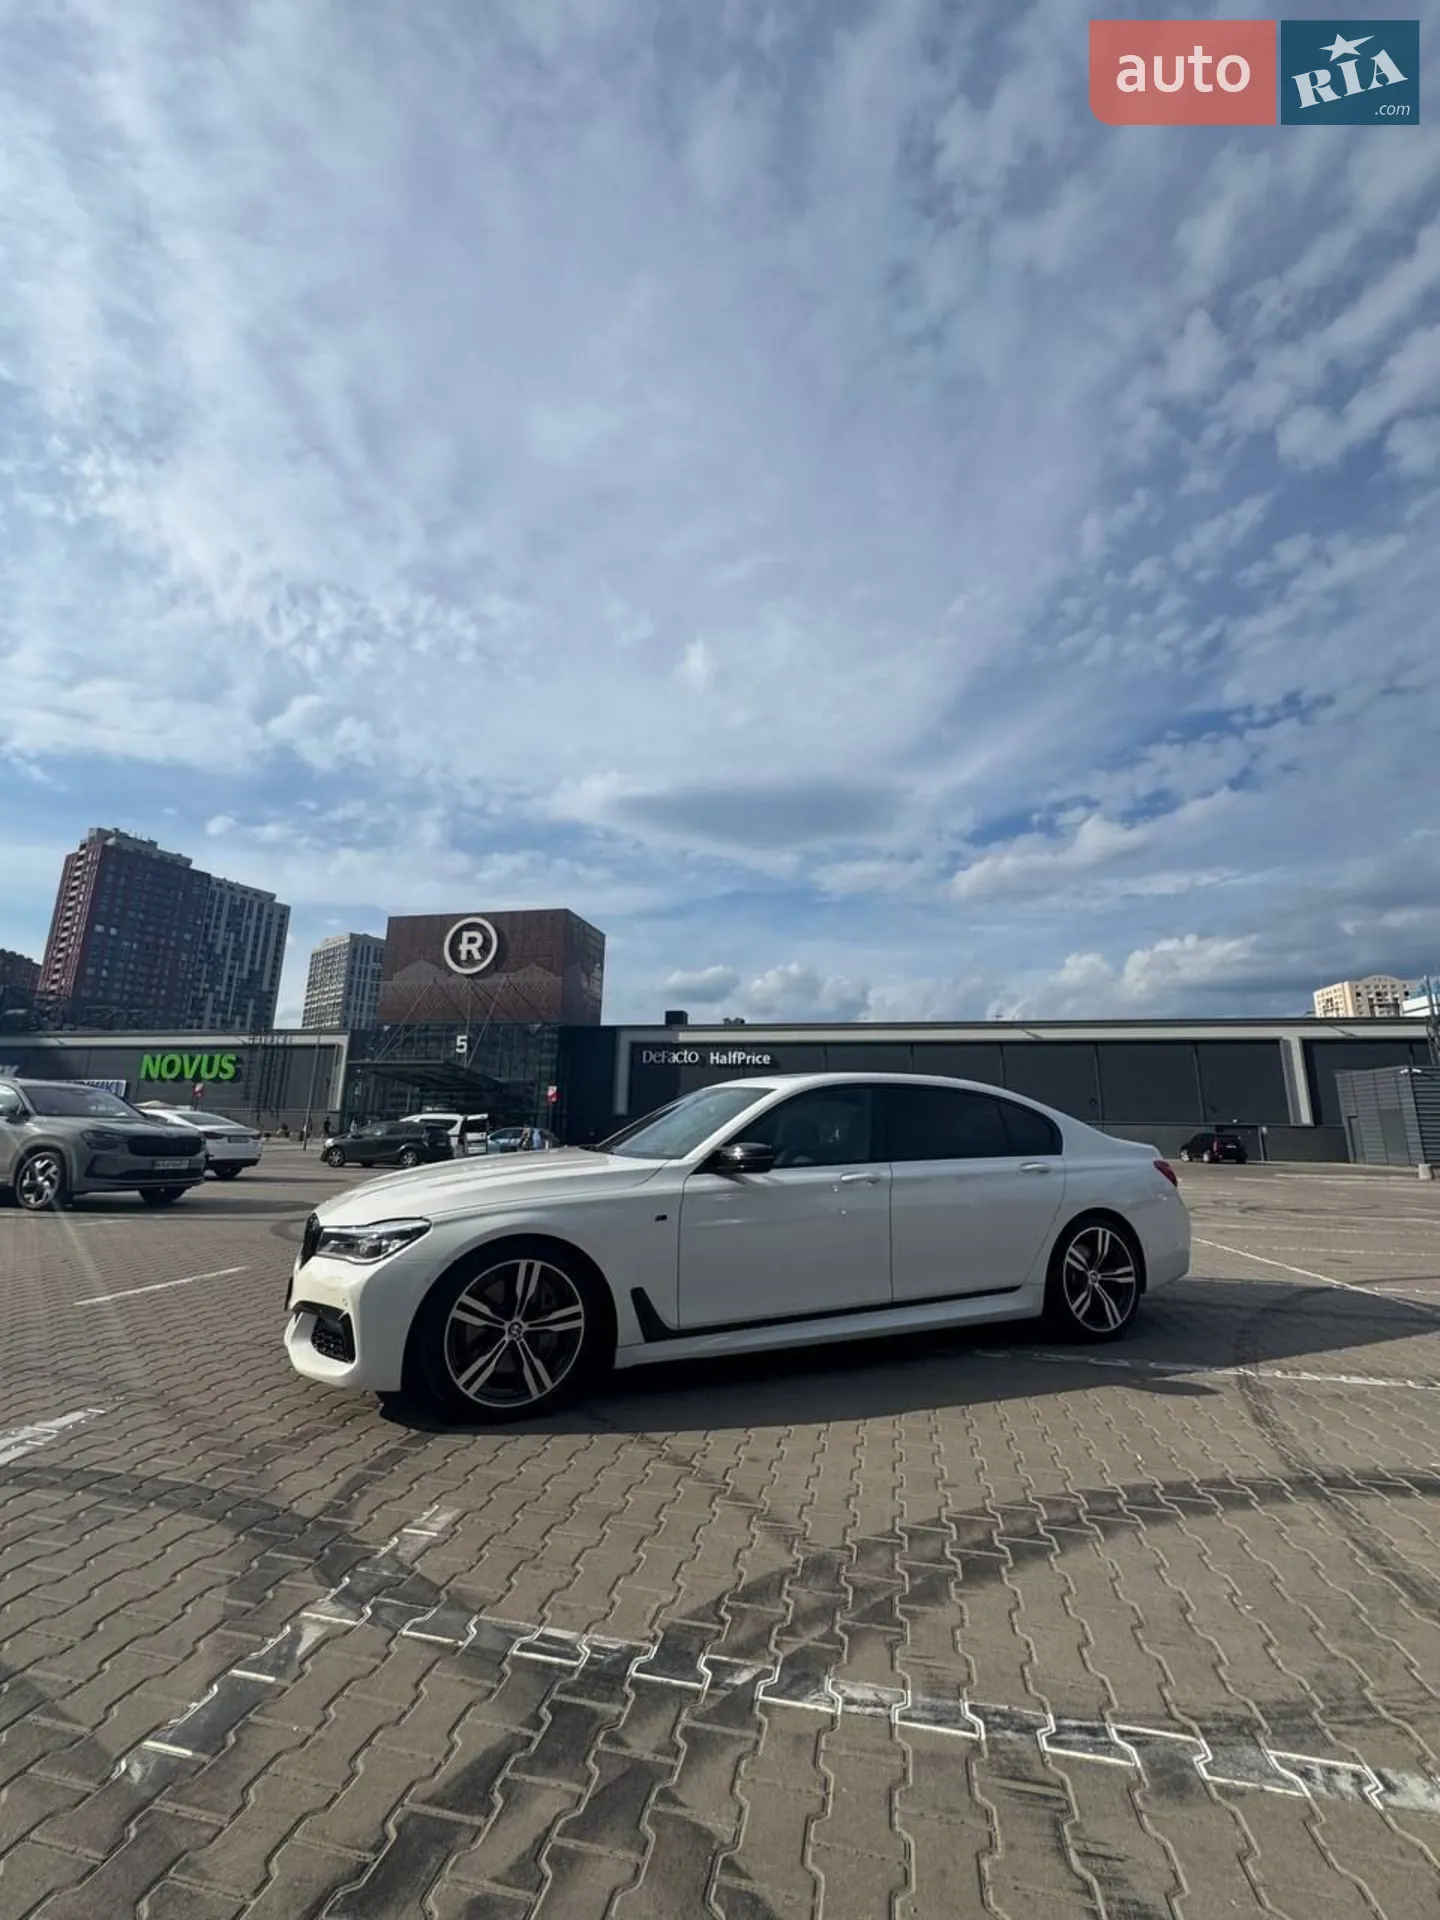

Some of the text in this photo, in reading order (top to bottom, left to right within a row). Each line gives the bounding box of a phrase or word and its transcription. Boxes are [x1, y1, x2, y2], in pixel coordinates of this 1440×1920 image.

[455, 1035, 468, 1053] 5
[642, 1050, 699, 1064] DeFacto
[710, 1051, 771, 1065] HalfPrice
[140, 1053, 236, 1080] NOVUS
